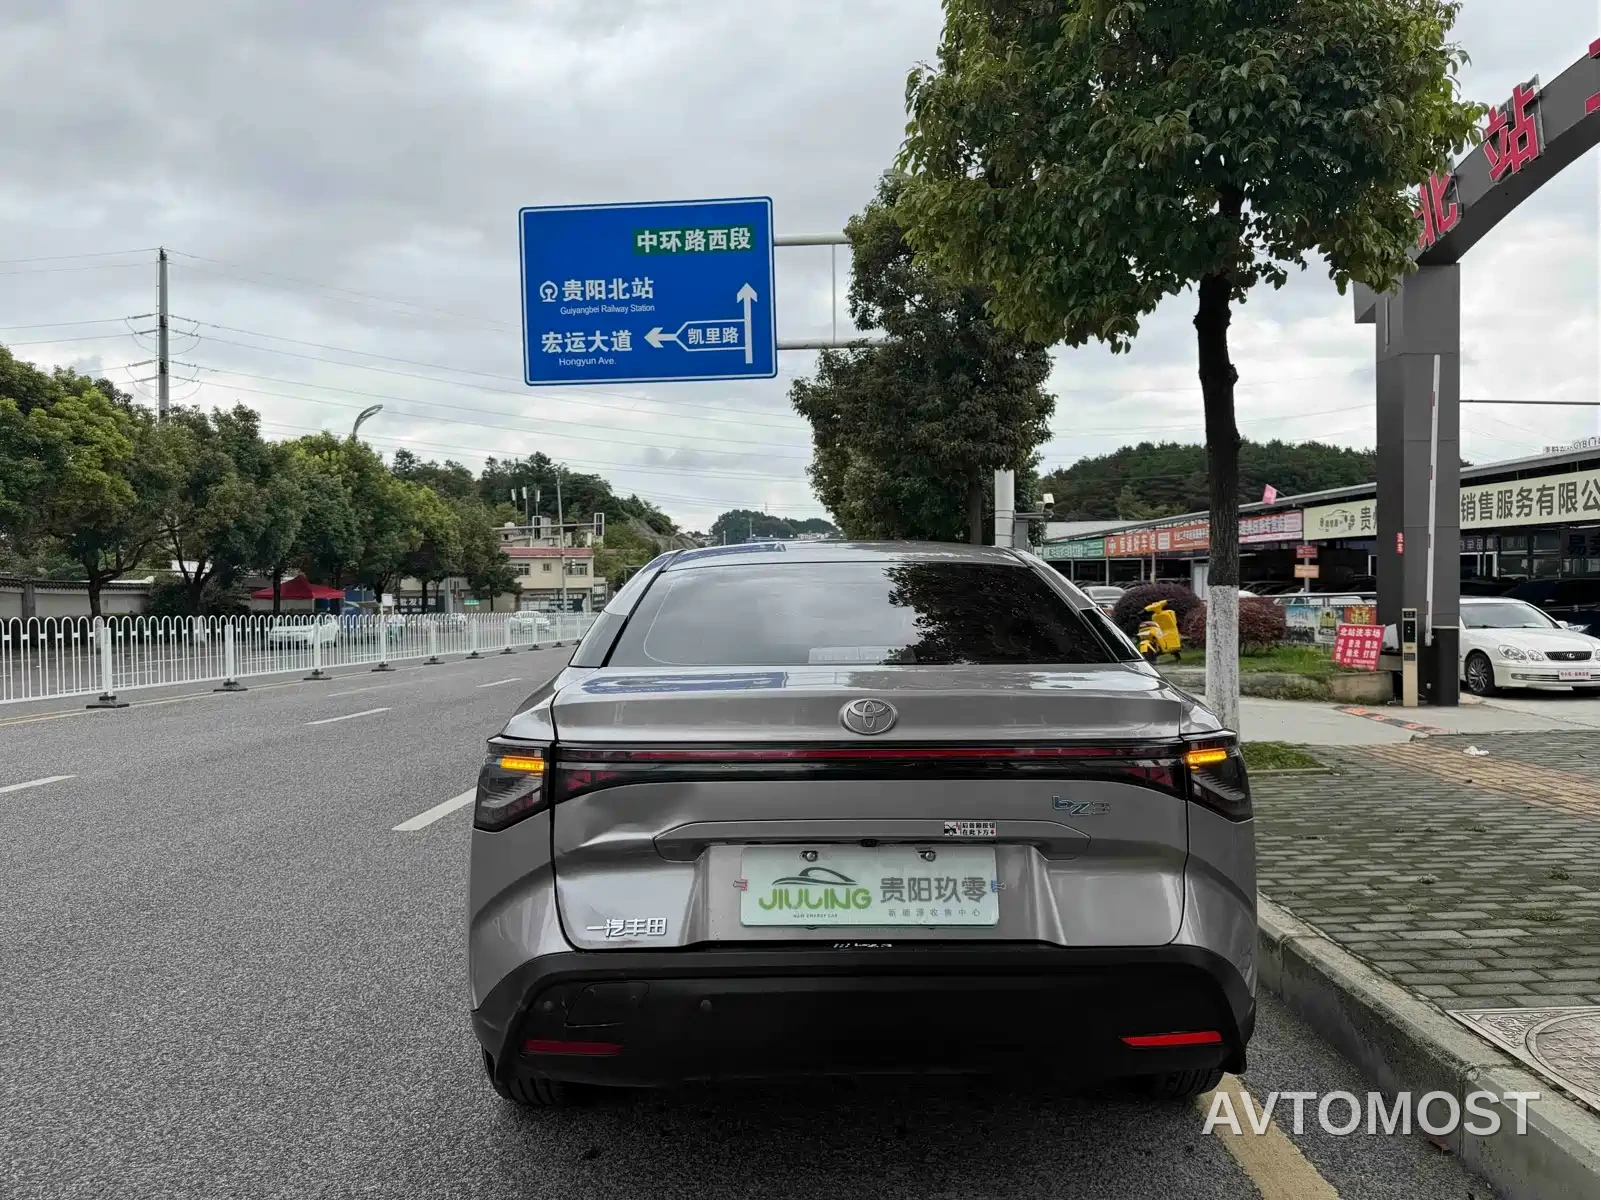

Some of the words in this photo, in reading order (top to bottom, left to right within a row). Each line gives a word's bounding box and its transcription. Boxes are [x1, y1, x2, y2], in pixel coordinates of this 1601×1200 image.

[636, 227, 752, 253] 中环路西段
[561, 277, 654, 302] 贵阳北站
[560, 306, 599, 316] Guiyangbei
[601, 304, 629, 315] Railway
[630, 303, 655, 313] Station
[541, 330, 633, 353] 宏运大道
[687, 326, 739, 345] 凯里路
[558, 356, 597, 367] Hongyun
[598, 356, 617, 366] Ave.
[1340, 627, 1381, 638] 北站洗车场
[759, 888, 872, 911] JIULING
[880, 877, 987, 904] 贵阳玖零
[587, 917, 667, 937] 一汽丰田
